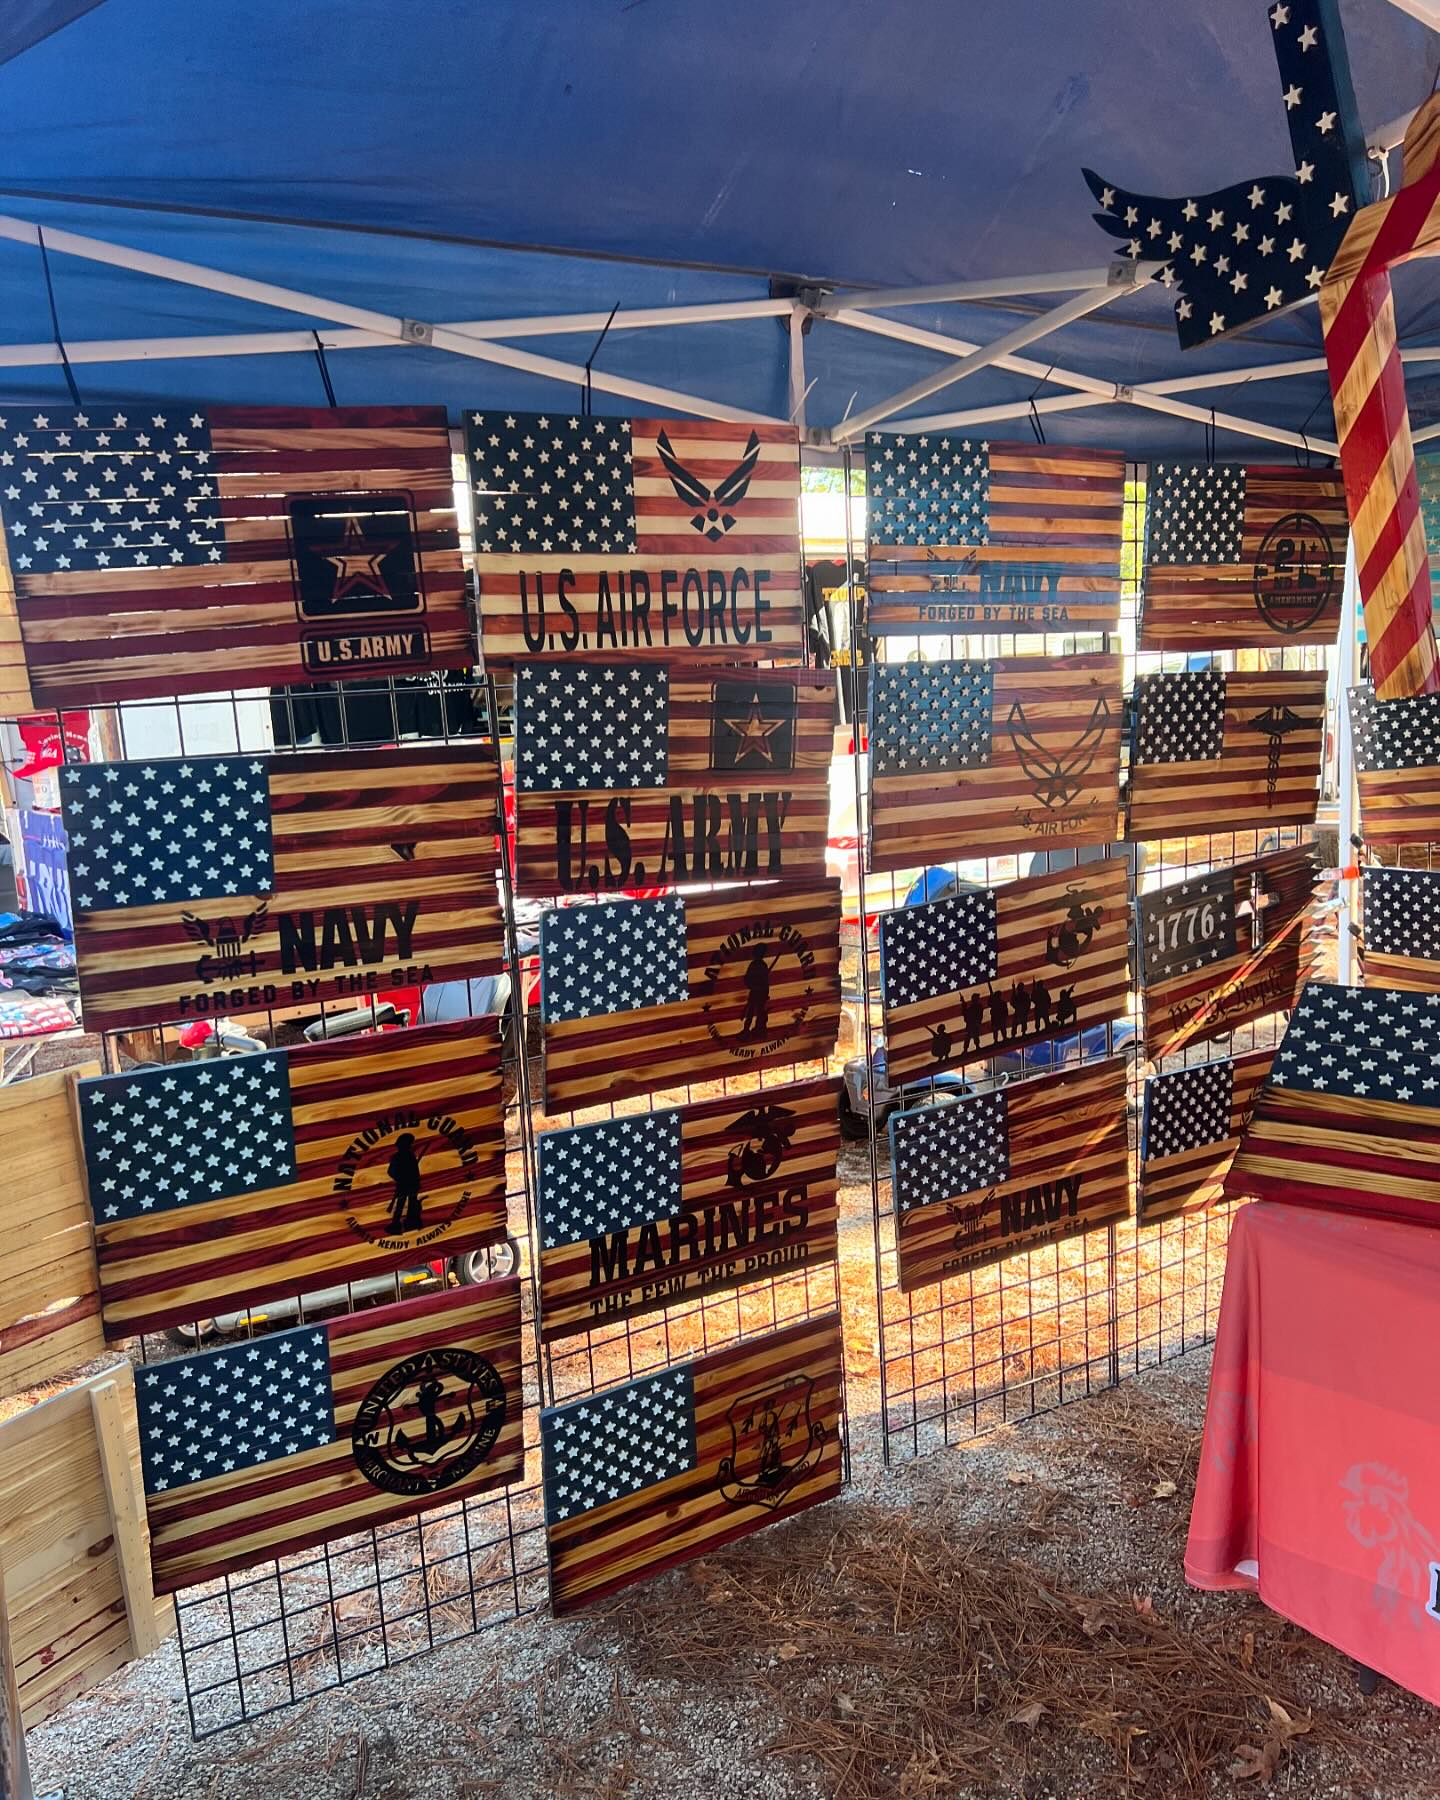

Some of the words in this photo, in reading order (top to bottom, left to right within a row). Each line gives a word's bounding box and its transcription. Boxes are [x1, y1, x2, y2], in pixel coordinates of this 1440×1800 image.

[518, 568, 589, 653] U.S.
[597, 569, 653, 649] AIR
[661, 566, 773, 647] FORCE
[919, 605, 976, 621] FORGED
[983, 605, 1001, 620] BY
[1009, 605, 1035, 621] THE
[1042, 605, 1069, 621] SEA
[979, 560, 1062, 601] NAVY
[554, 797, 646, 892] U.S.
[657, 791, 794, 884] ARMY
[1034, 821, 1058, 835] AIR
[277, 901, 422, 977] NAVY
[1156, 903, 1215, 952] 1776
[179, 984, 276, 1015] FORGED
[291, 979, 321, 1001] BY
[335, 971, 379, 995] THE
[391, 964, 435, 987] SEA
[333, 1110, 421, 1191] NATIONAL
[427, 1115, 480, 1167] GUARD
[588, 1184, 810, 1290] MARINES
[1000, 1173, 1084, 1238] NAVY
[377, 1239, 410, 1250] READY
[589, 1288, 634, 1322] THE
[642, 1275, 688, 1301] FEW
[698, 1260, 737, 1284] THE
[744, 1243, 810, 1273] PROUD
